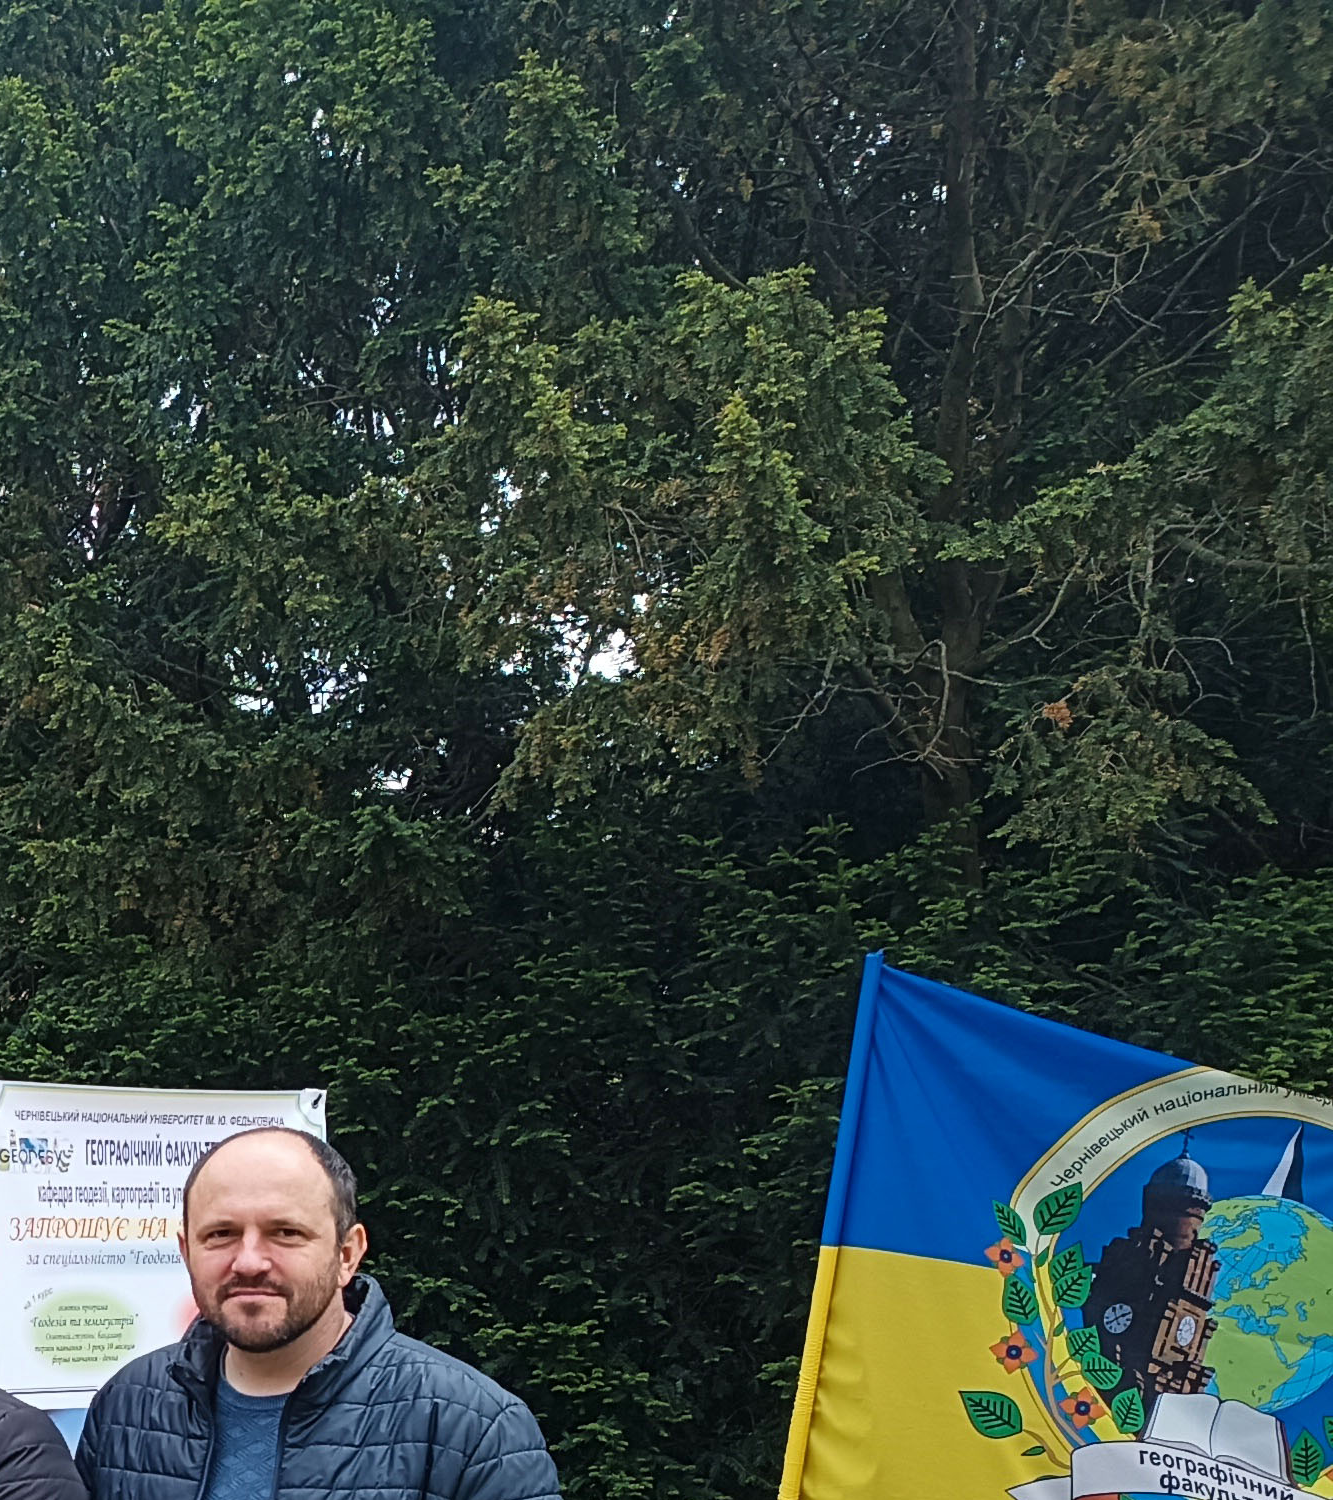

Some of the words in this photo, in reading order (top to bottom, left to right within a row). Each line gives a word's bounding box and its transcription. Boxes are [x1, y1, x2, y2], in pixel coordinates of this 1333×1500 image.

[14, 1110, 79, 1123] ЧЕРНІВЕЦЬКИЙ
[81, 1112, 148, 1125] НАЦІОНАЛЬНИЙ
[149, 1114, 204, 1125] УНІВЕРСИТЕТ
[230, 1116, 285, 1126] ФЕДЬКОВИЧА
[85, 1134, 162, 1166] ГЕОГРАФІЧНИЙ
[1050, 1106, 1150, 1188] Чернівецький
[38, 1181, 73, 1208] кафедра
[162, 1187, 171, 1203] та
[10, 1216, 129, 1242] ЗАПРОШУЄ
[137, 1217, 168, 1239] НА
[26, 1252, 40, 1265] за
[43, 1250, 126, 1267] спеціальністю
